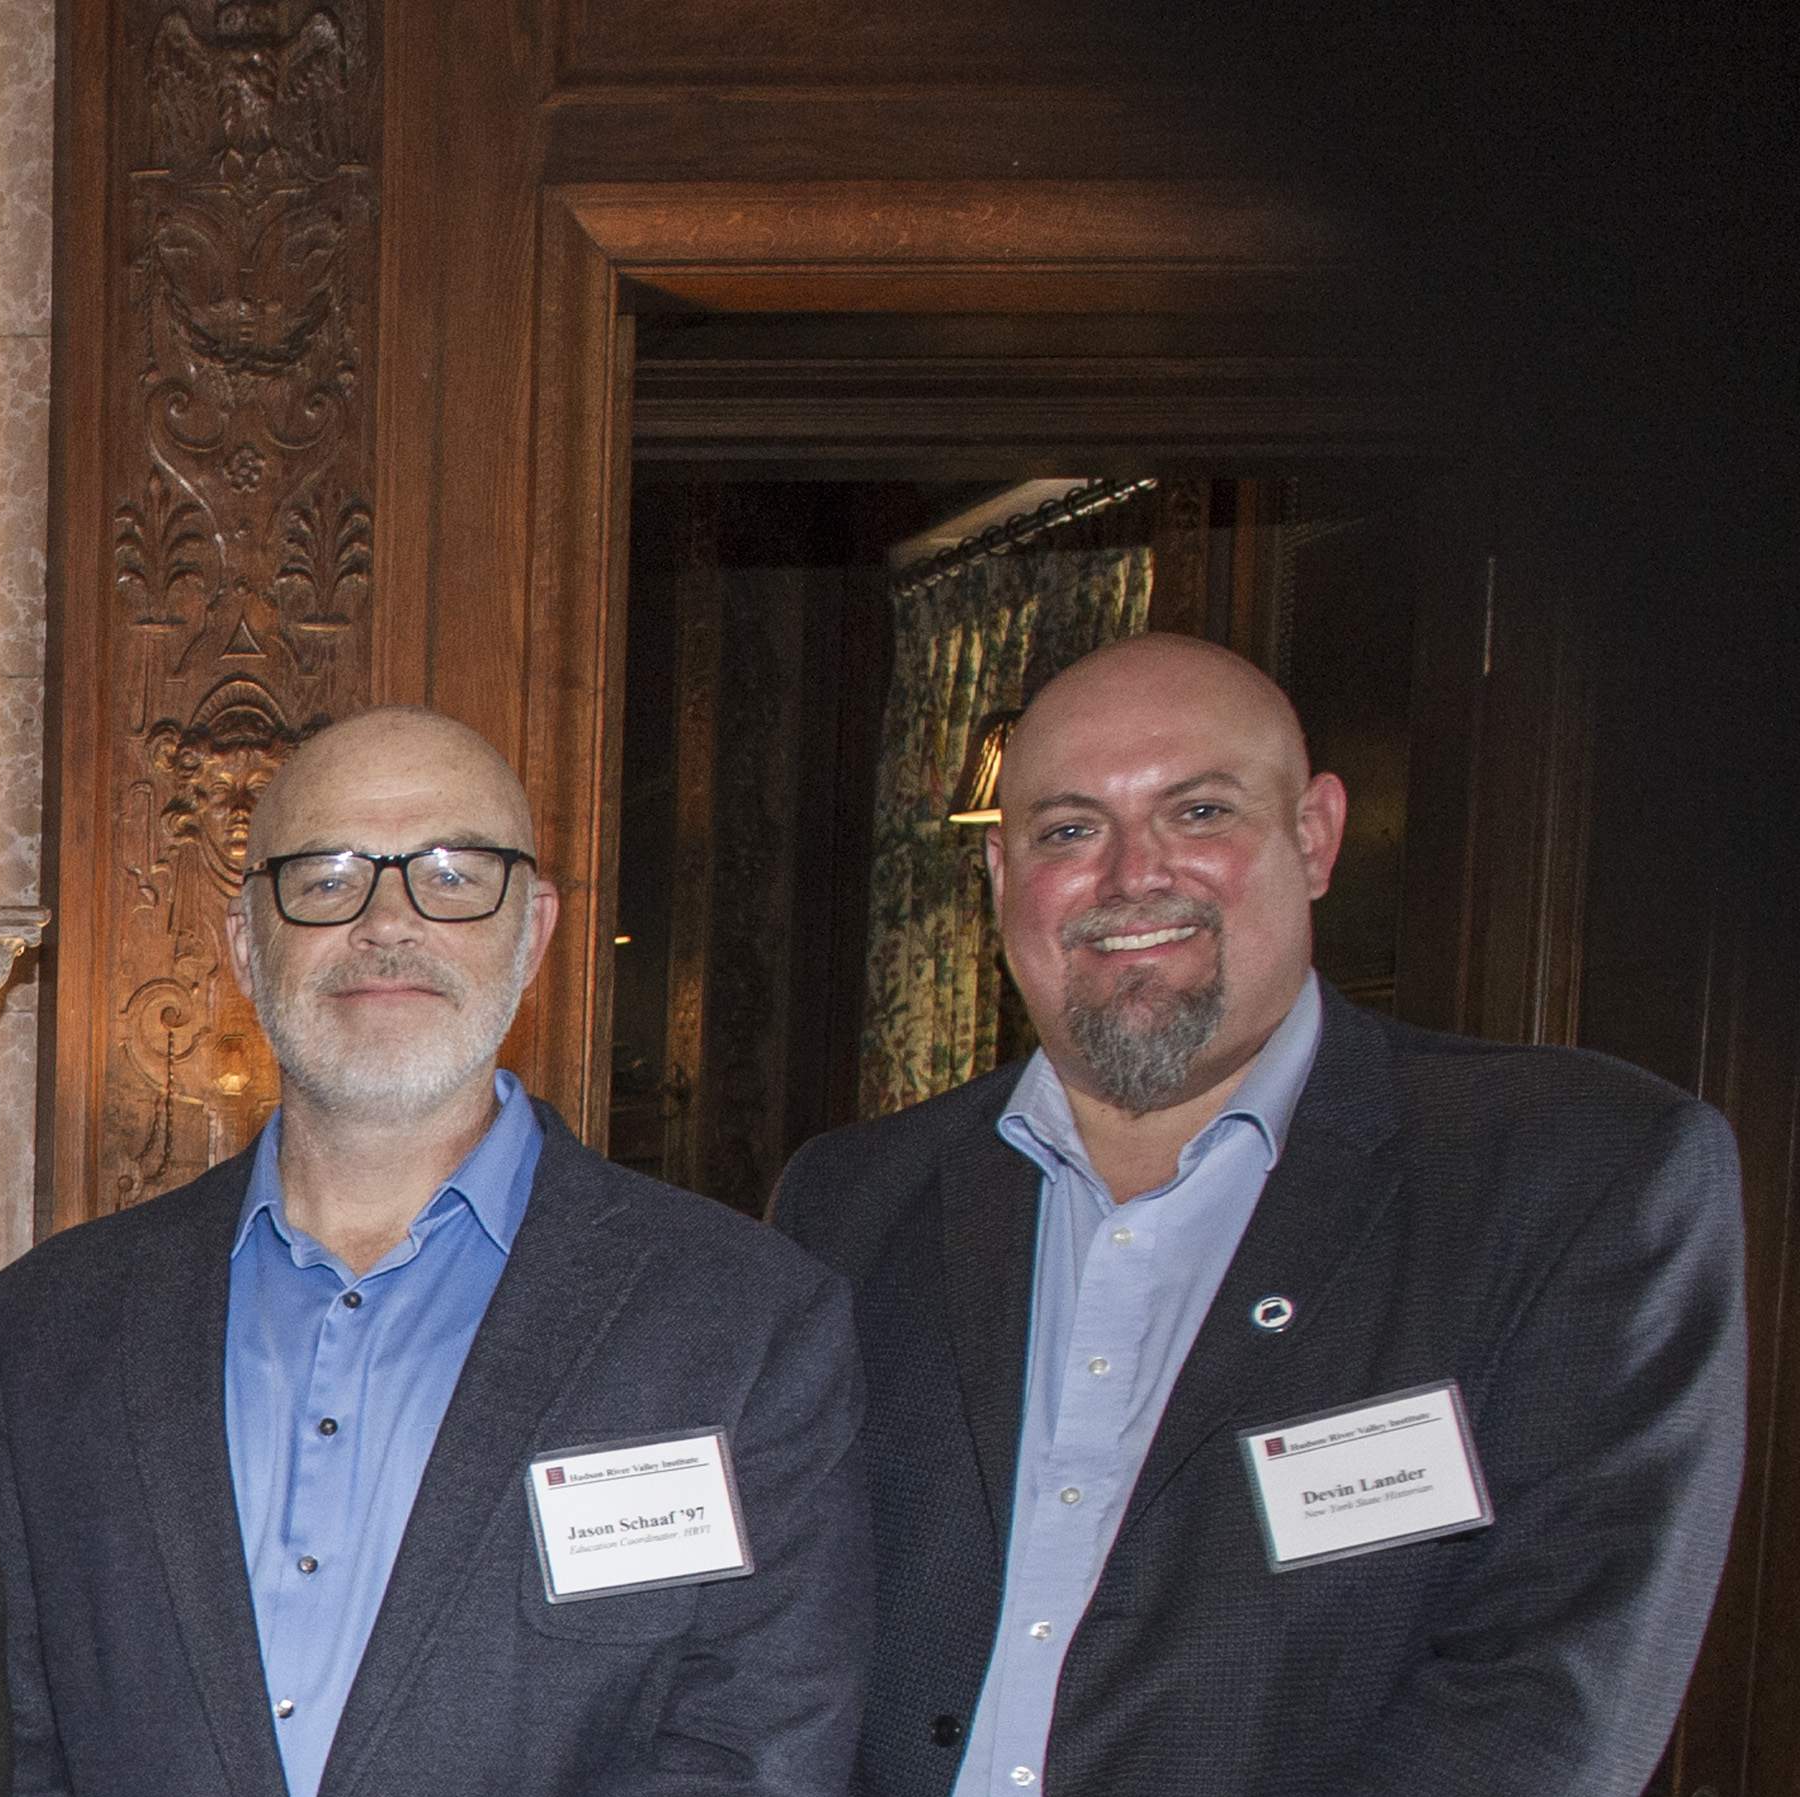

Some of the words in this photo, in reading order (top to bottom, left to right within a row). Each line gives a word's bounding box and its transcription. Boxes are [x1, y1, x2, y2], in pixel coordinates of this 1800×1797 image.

[1328, 1430, 1355, 1443] River
[1357, 1422, 1387, 1435] Valley
[569, 1470, 604, 1483] Hudson
[606, 1465, 631, 1478] River
[633, 1461, 660, 1475] Valley
[661, 1456, 699, 1469] Institute
[1302, 1485, 1355, 1505] Devin
[1359, 1468, 1427, 1492] Lander
[568, 1523, 615, 1540] Jason
[619, 1510, 677, 1533] Schaaf
